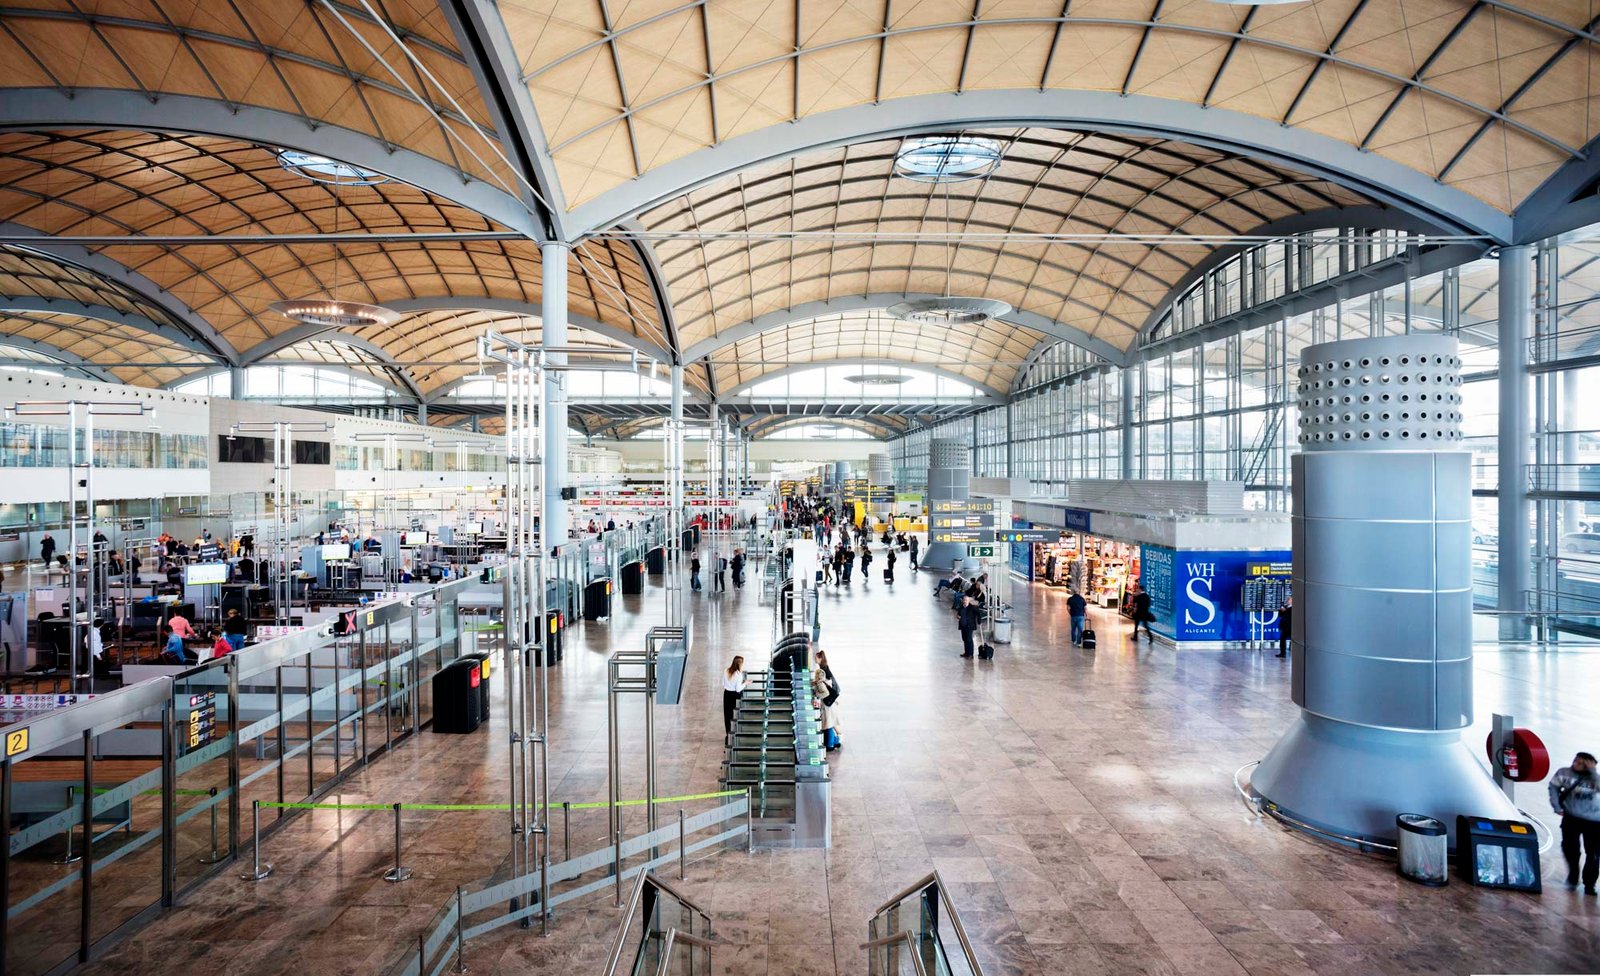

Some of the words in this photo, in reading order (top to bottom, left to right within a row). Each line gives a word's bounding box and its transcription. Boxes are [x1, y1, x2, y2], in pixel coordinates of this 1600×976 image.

[1145, 550, 1172, 565] BEBIDAS
[1186, 563, 1215, 576] WH
[1185, 577, 1215, 626] S
[12, 733, 22, 752] 2
